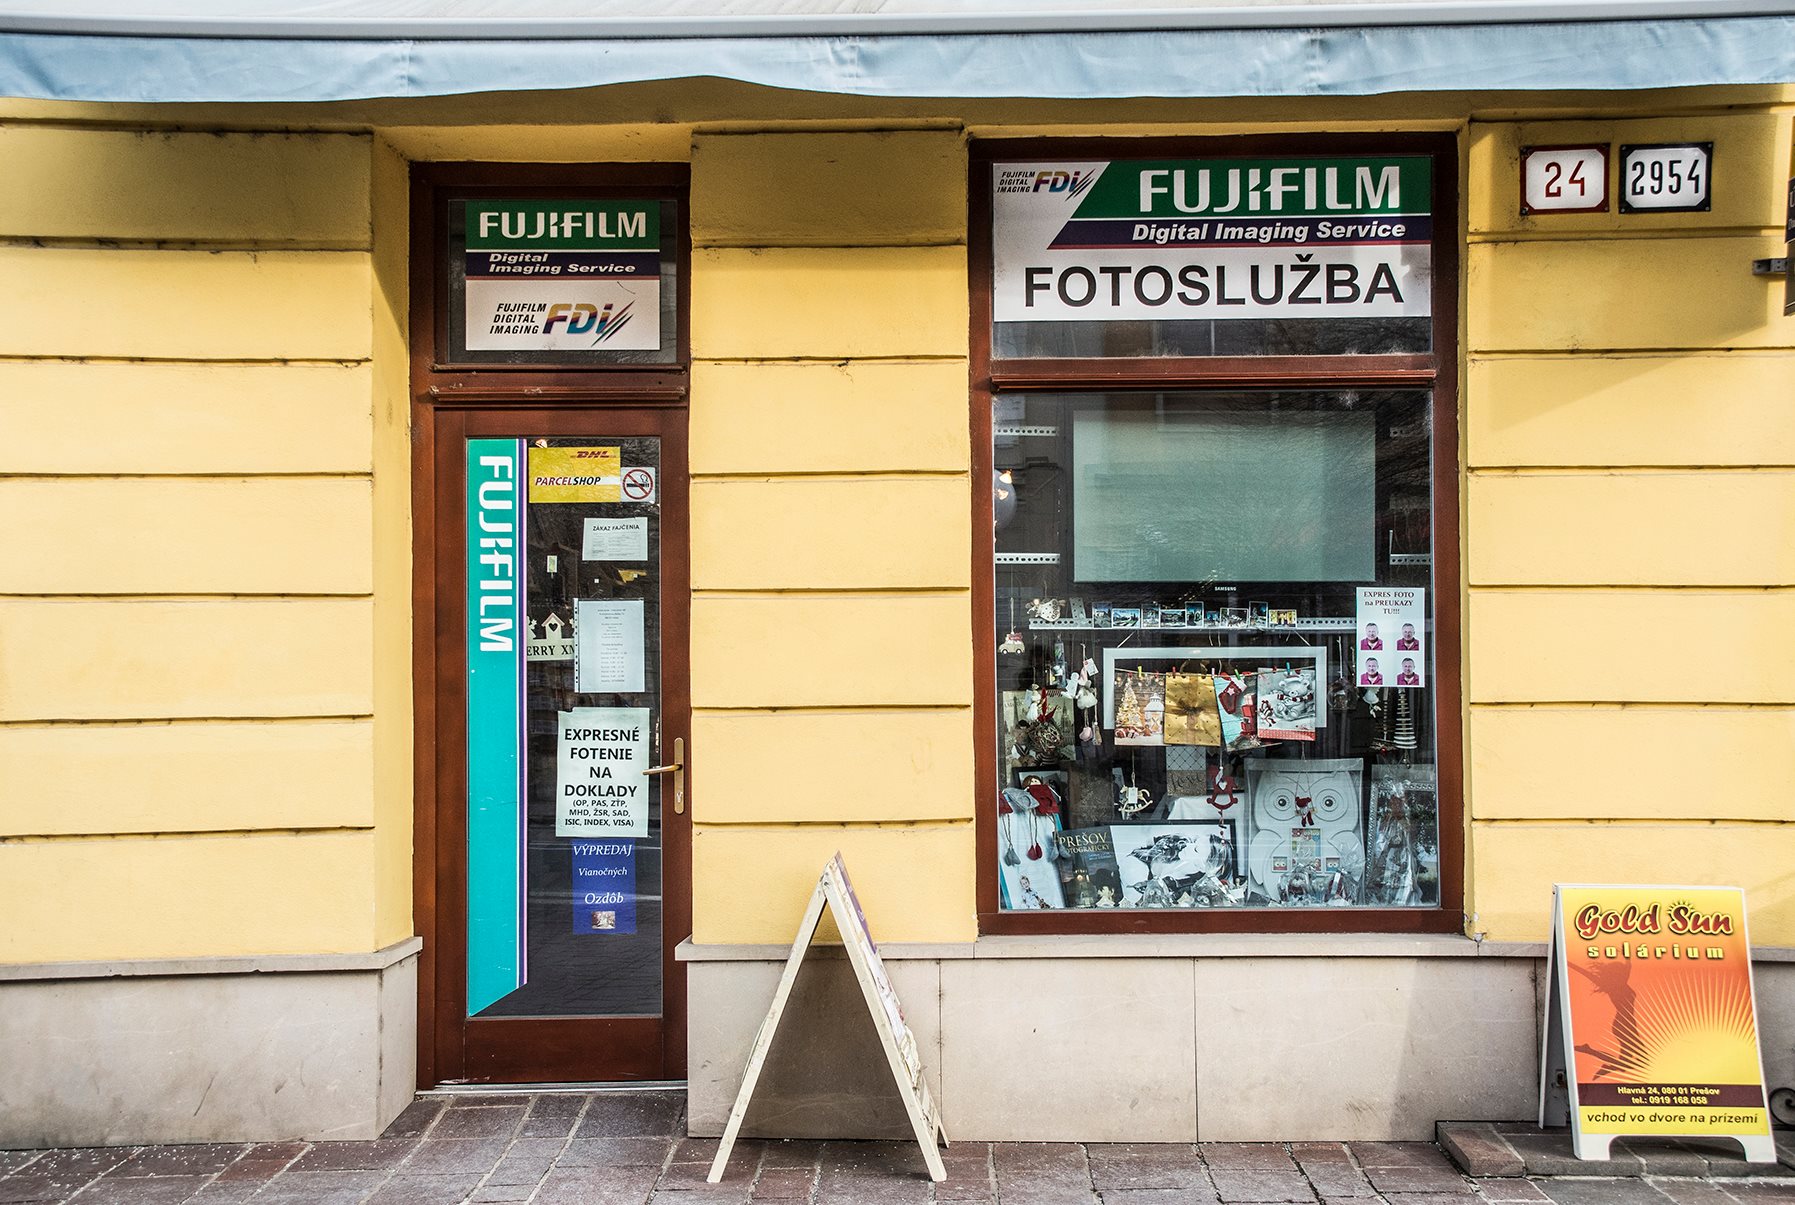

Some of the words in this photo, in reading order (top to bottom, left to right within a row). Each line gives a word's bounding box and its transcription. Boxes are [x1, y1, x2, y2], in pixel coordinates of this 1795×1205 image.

[999, 178, 1028, 186] DIGITAL
[1544, 159, 1586, 198] 24
[1631, 158, 1700, 196] 2954
[1139, 165, 1400, 213] FUJIFILM
[479, 211, 647, 239] FUJIFILM
[1132, 222, 1209, 245] Digital
[1214, 222, 1310, 244] Imaging
[1316, 220, 1406, 239] Service
[488, 253, 549, 264] Digital
[488, 263, 562, 274] Imaging
[567, 263, 636, 273] Service
[1024, 253, 1405, 307] FOTOSLUŽBA
[496, 303, 547, 312] FUJIFILM
[493, 314, 536, 323] DIGITAL
[489, 325, 539, 334] IMAGING
[576, 450, 610, 459] DHL
[535, 476, 602, 486] PARCELSHOP
[478, 455, 513, 652] FUJIFILM
[564, 726, 640, 742] EXPRESNÉ
[570, 747, 633, 760] FOTENIE
[589, 766, 613, 779] NA
[564, 784, 638, 798] DOKLADY
[572, 799, 590, 808] (OP,
[591, 799, 609, 808] PAS,
[568, 808, 591, 818] MHD,
[593, 807, 611, 817] ŽSR,
[612, 809, 631, 818] SAD,
[565, 818, 582, 826] ISIC,
[584, 818, 611, 827] INDEX,
[612, 819, 635, 828] VISA)
[573, 843, 633, 857] VÝPREDAJ
[578, 866, 628, 878] Vianočných
[584, 891, 624, 905] Ozdôb
[1577, 904, 1662, 938] Gold
[1669, 903, 1733, 934] Sun
[1588, 942, 1725, 958] solárium
[1617, 1086, 1647, 1095] Hlavná
[1647, 1086, 1660, 1096] 24,
[1661, 1087, 1677, 1095] 080
[1678, 1087, 1689, 1095] 01
[1690, 1087, 1720, 1095] Prešov
[1631, 1096, 1648, 1105] tel.:
[1649, 1096, 1671, 1105] 0919
[1673, 1096, 1689, 1105] 168
[1690, 1096, 1708, 1105] 058
[1587, 1112, 1626, 1123] vchod
[1630, 1115, 1645, 1123] vo
[1649, 1112, 1686, 1123] dvore
[1690, 1115, 1706, 1123] na
[1709, 1112, 1759, 1126] prízemí
